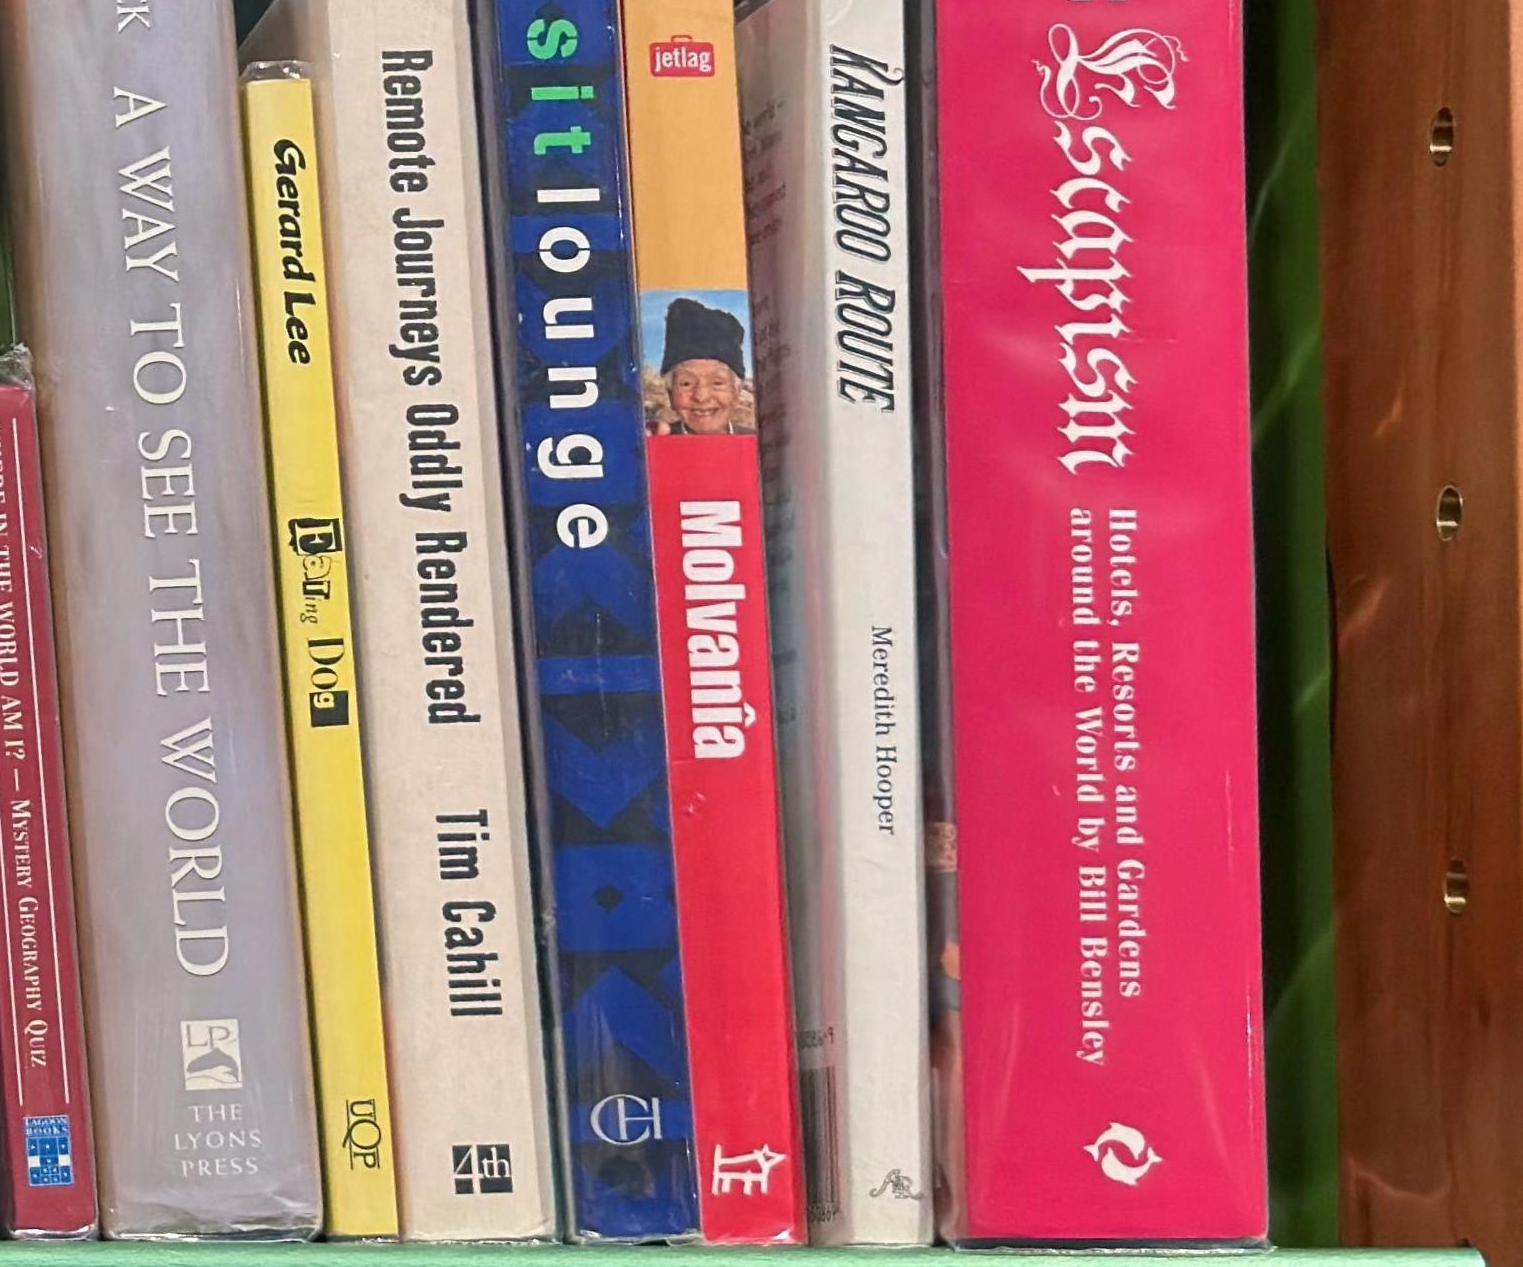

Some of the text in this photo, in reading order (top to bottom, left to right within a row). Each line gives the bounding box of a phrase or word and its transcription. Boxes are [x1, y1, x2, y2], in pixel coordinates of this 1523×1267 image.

[112, 85, 168, 129] A
[654, 46, 712, 73] jetlag
[117, 145, 181, 284] WAY
[272, 138, 318, 366] Gerard Lee
[830, 43, 906, 415] KANGAROO ROUTE
[128, 301, 187, 406] TO
[380, 49, 482, 725] Remote Journeys Oddly Rendered
[536, 186, 609, 551] lounge
[137, 428, 200, 539] SEE
[147, 558, 211, 698] THE
[871, 624, 899, 836] Meredith Hooper
[1069, 507, 1111, 1066] around the World by Bill Bensley
[1106, 509, 1148, 999] Hotels, Resorts and Gardens
[159, 715, 230, 977] WORLD
[434, 807, 504, 1019] Tim Cahill
[174, 1129, 263, 1152] LYONS
[181, 1156, 260, 1178] PRESS
[187, 1103, 244, 1123] THE
